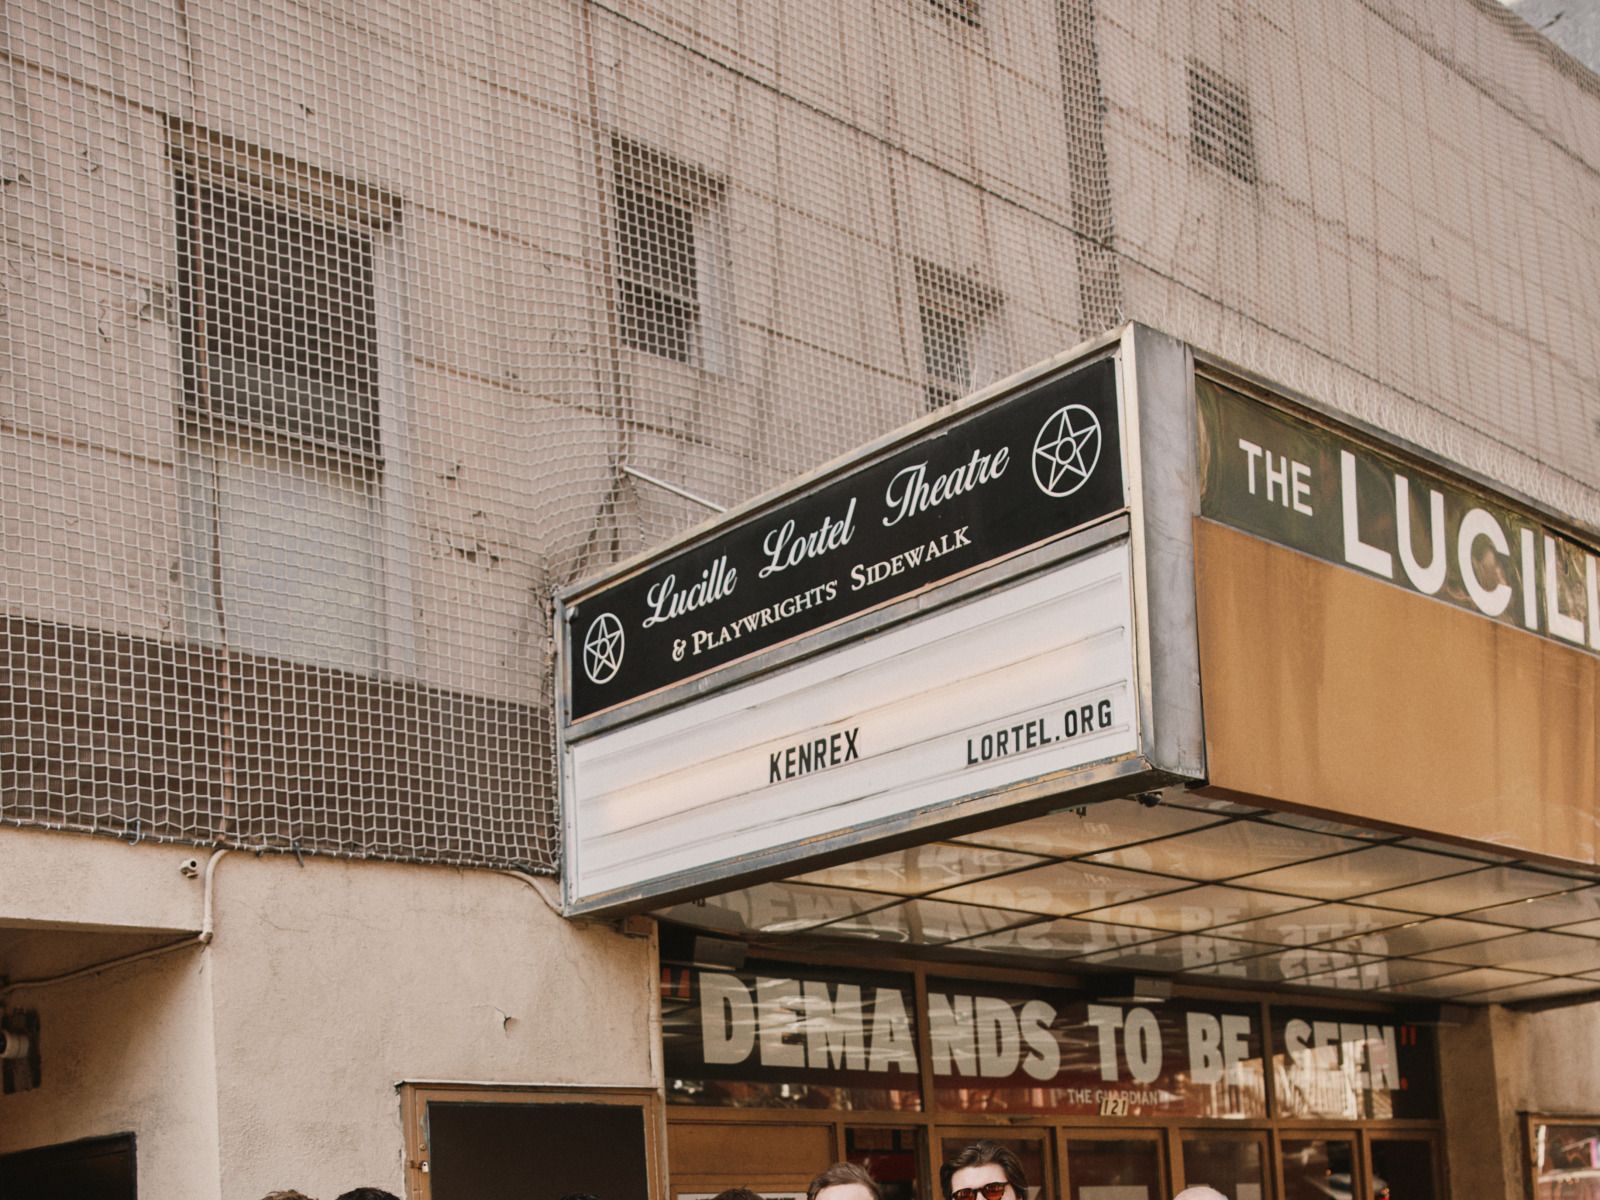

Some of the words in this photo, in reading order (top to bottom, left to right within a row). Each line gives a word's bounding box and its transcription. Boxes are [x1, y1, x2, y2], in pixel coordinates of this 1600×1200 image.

[1239, 438, 1313, 517] THE
[642, 555, 738, 629] Lucille
[757, 497, 858, 579] Lortel
[882, 445, 1011, 527] Theatre
[671, 638, 687, 662] &
[850, 525, 972, 591] SIDEWALK
[769, 727, 860, 784] KENREX
[967, 699, 1112, 765] LORTEL.ORG
[1087, 1003, 1163, 1084] TO
[1186, 1011, 1253, 1086] BE
[1067, 1088, 1093, 1104] THE
[1095, 1089, 1158, 1106] GUARDIAN
[1102, 1099, 1127, 1115] 121
